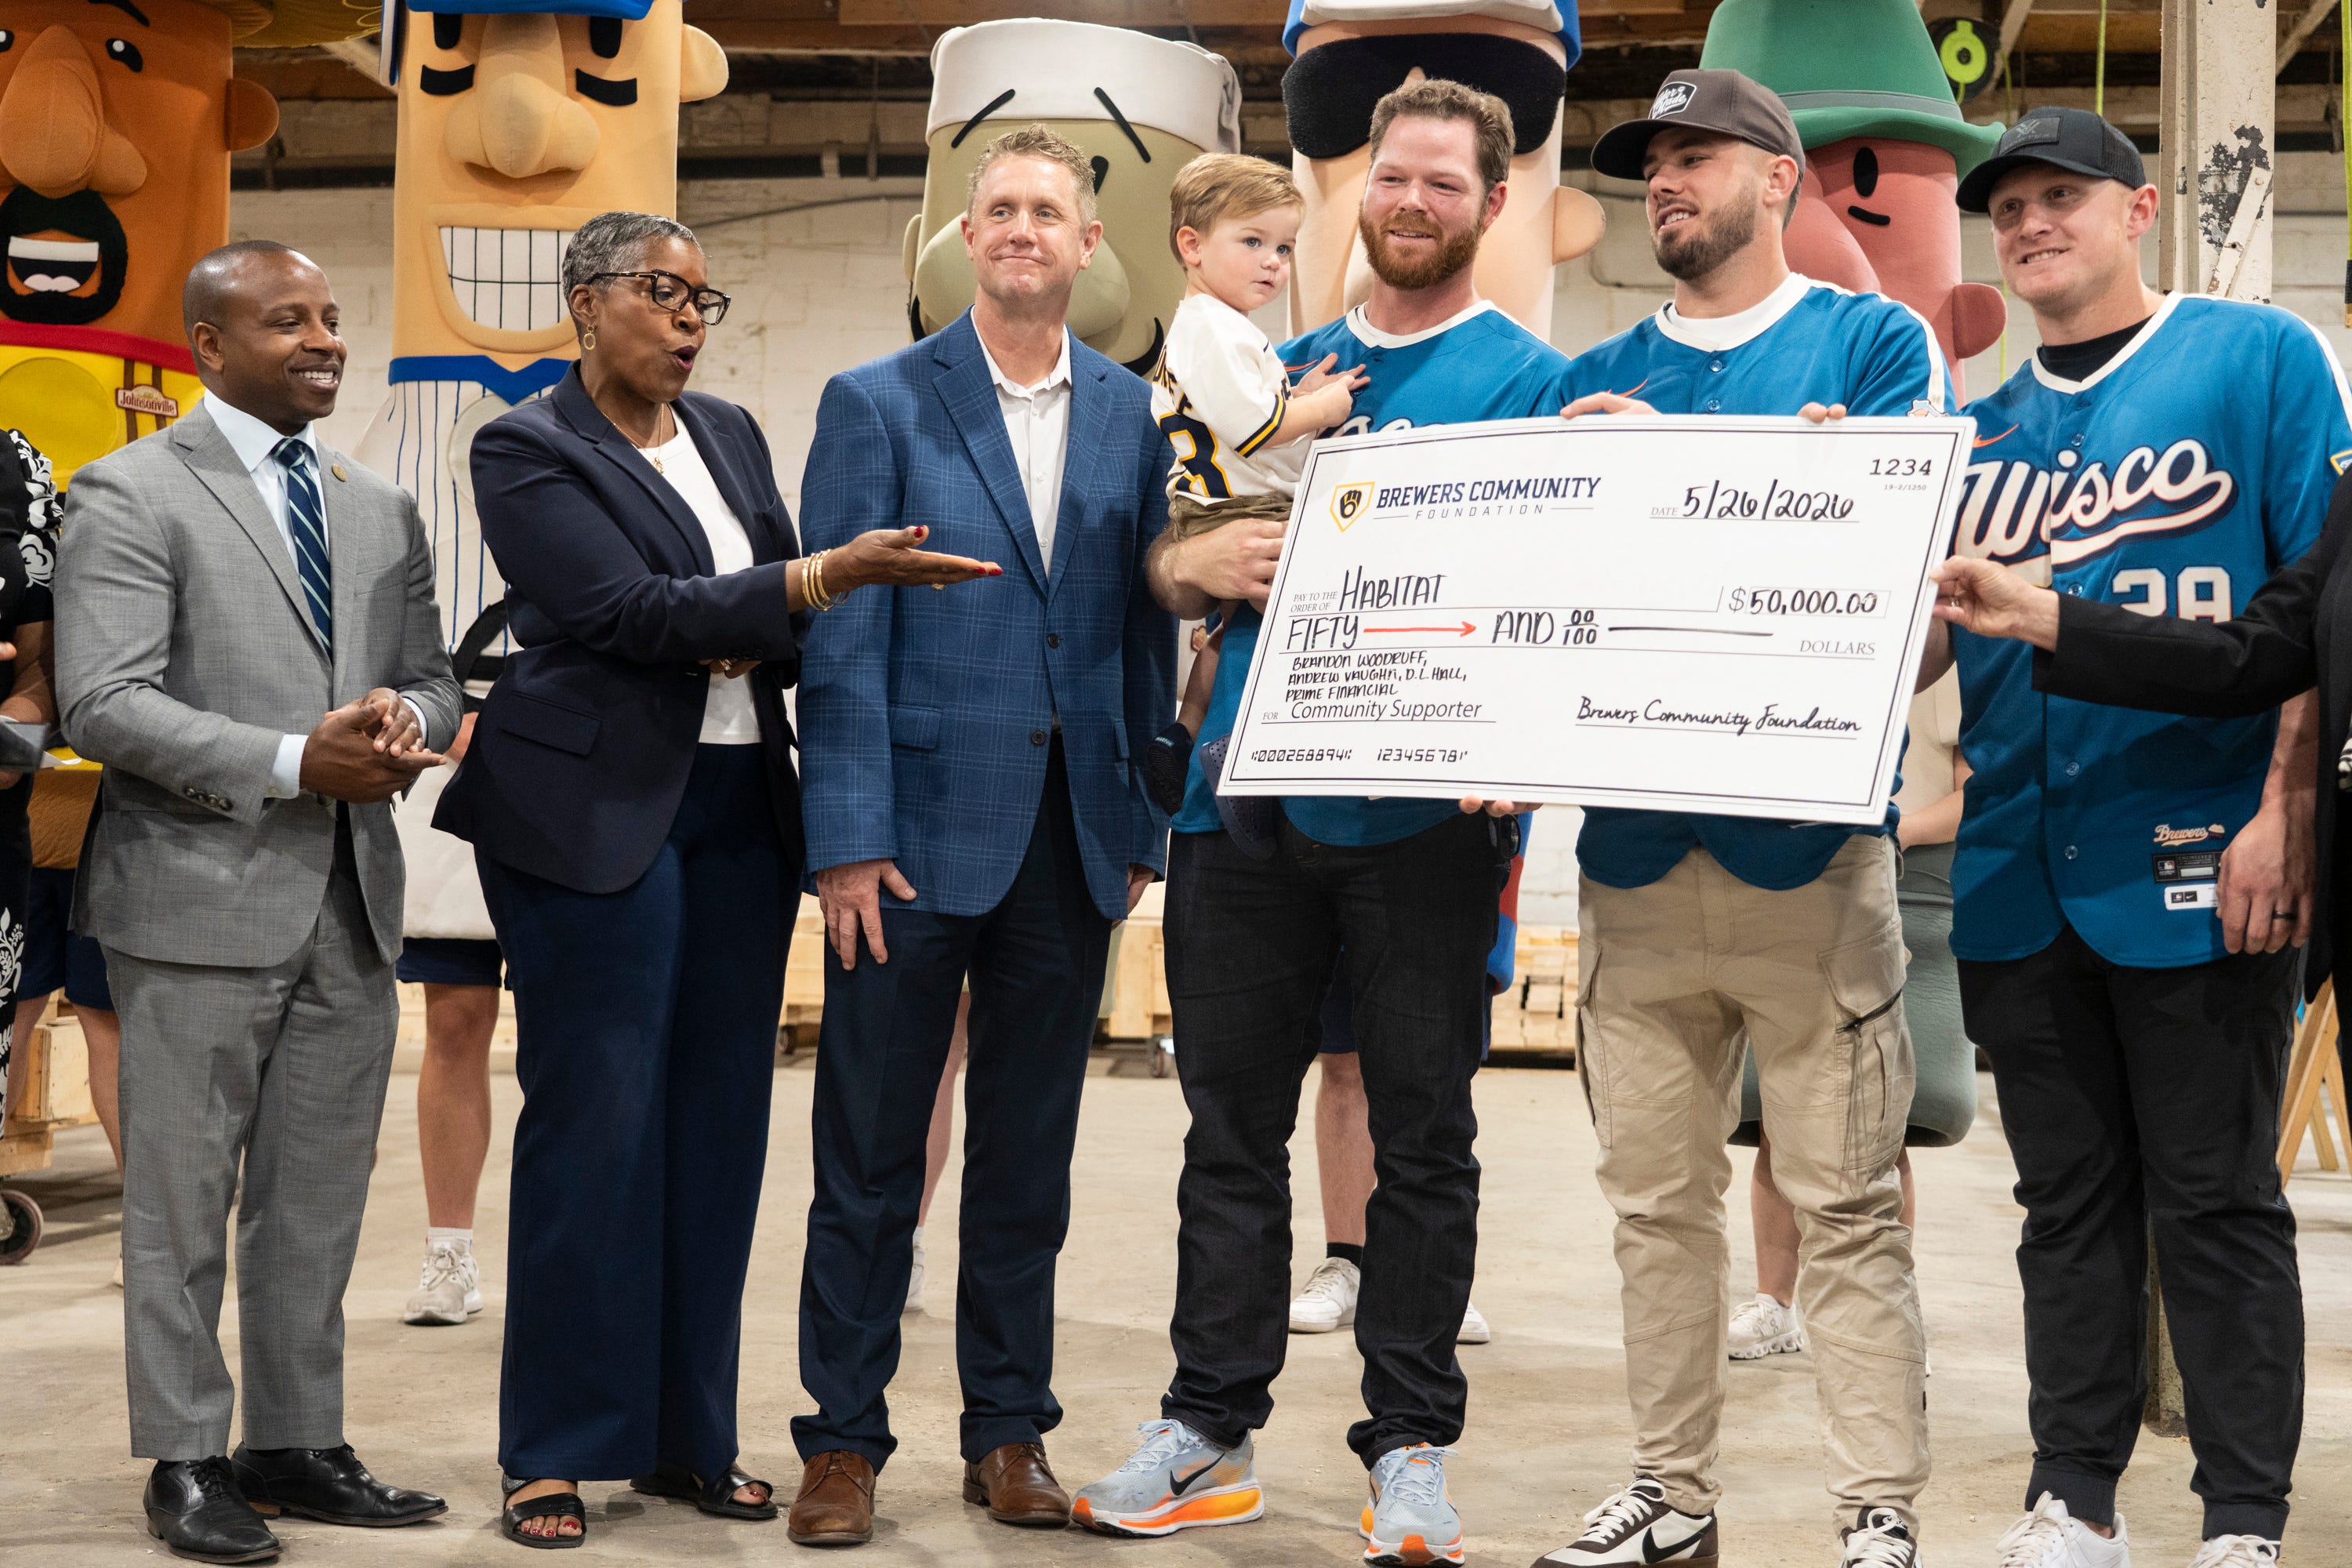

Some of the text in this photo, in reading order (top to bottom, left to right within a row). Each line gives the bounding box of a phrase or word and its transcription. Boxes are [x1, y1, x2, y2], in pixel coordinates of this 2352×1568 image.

[120, 391, 175, 413] Johnsonville
[1869, 459, 1932, 476] 1234
[1376, 477, 1602, 509] BREWERS COMMUNITY
[1682, 479, 1854, 521] 5/26/2026
[1416, 504, 1544, 520] FOUNDATION
[1650, 506, 1679, 516] DATE
[1294, 593, 1308, 602] PAY
[1322, 591, 1338, 600] THE
[1339, 565, 1448, 612] HABITAT
[1290, 604, 1317, 613] ORDER
[1287, 615, 1359, 652] FIFTY
[1492, 611, 1555, 644] AND
[1800, 640, 1875, 655] DOLLARS
[1293, 650, 1428, 671] BRANDON WOODRUFF,
[1288, 672, 1339, 686] ANDREW
[1286, 684, 1399, 702] PRIME FINANCIAL
[1263, 700, 1483, 722] FOR Community Supporter
[1577, 696, 1862, 736] Brewers Community Foundation
[2153, 824, 2209, 846] Brewers
